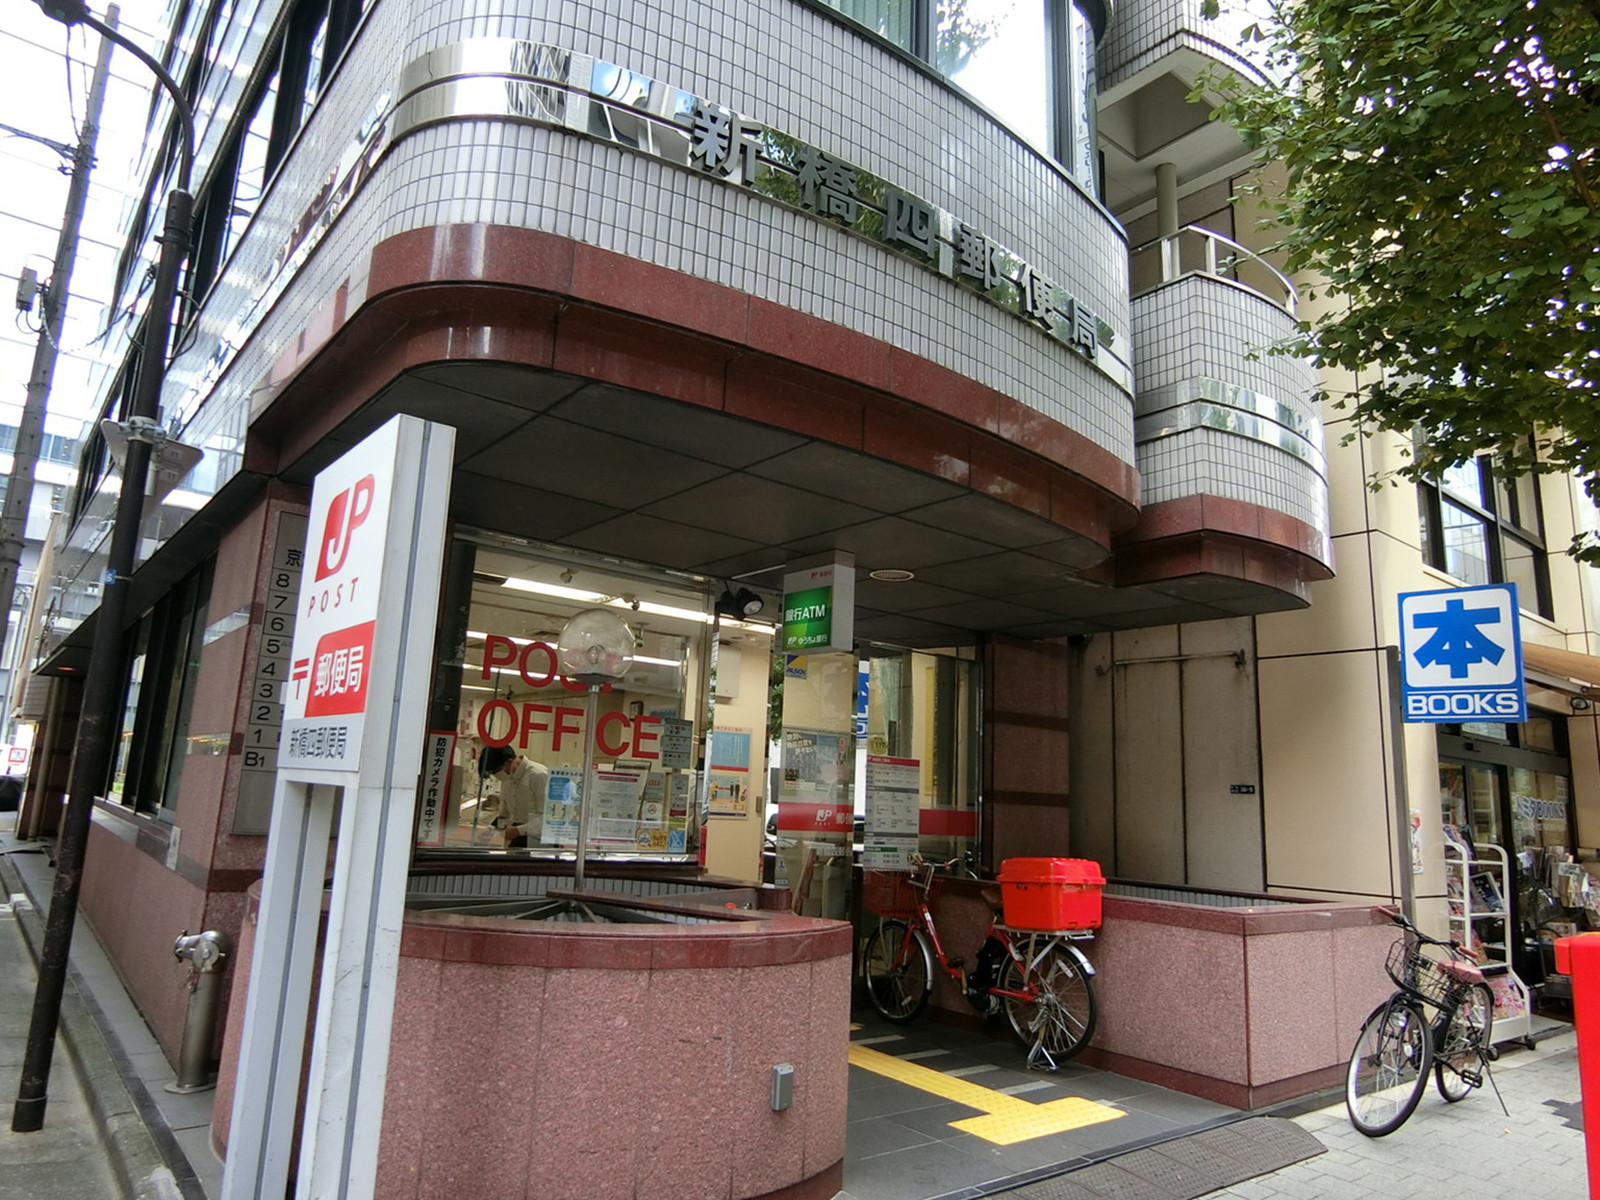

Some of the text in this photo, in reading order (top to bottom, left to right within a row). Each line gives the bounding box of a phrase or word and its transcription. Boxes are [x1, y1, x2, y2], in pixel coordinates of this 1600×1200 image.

[689, 103, 1099, 359] 新橋四郵便局
[276, 573, 290, 588] 8
[274, 595, 288, 610] 7
[307, 577, 359, 618] POST
[785, 604, 826, 622] 銀行ATM
[271, 617, 285, 632] 6
[266, 639, 280, 654] 5
[1413, 599, 1506, 679] 本
[262, 662, 276, 676] 4
[314, 645, 364, 697] 郵便局
[259, 683, 273, 698] 3
[1408, 692, 1520, 716] BOOKS
[256, 705, 270, 720] 2
[254, 729, 263, 743] 1
[477, 699, 663, 760] OFFCE
[244, 751, 265, 767] B1
[423, 737, 448, 840] 防犯カメラ作動中です
